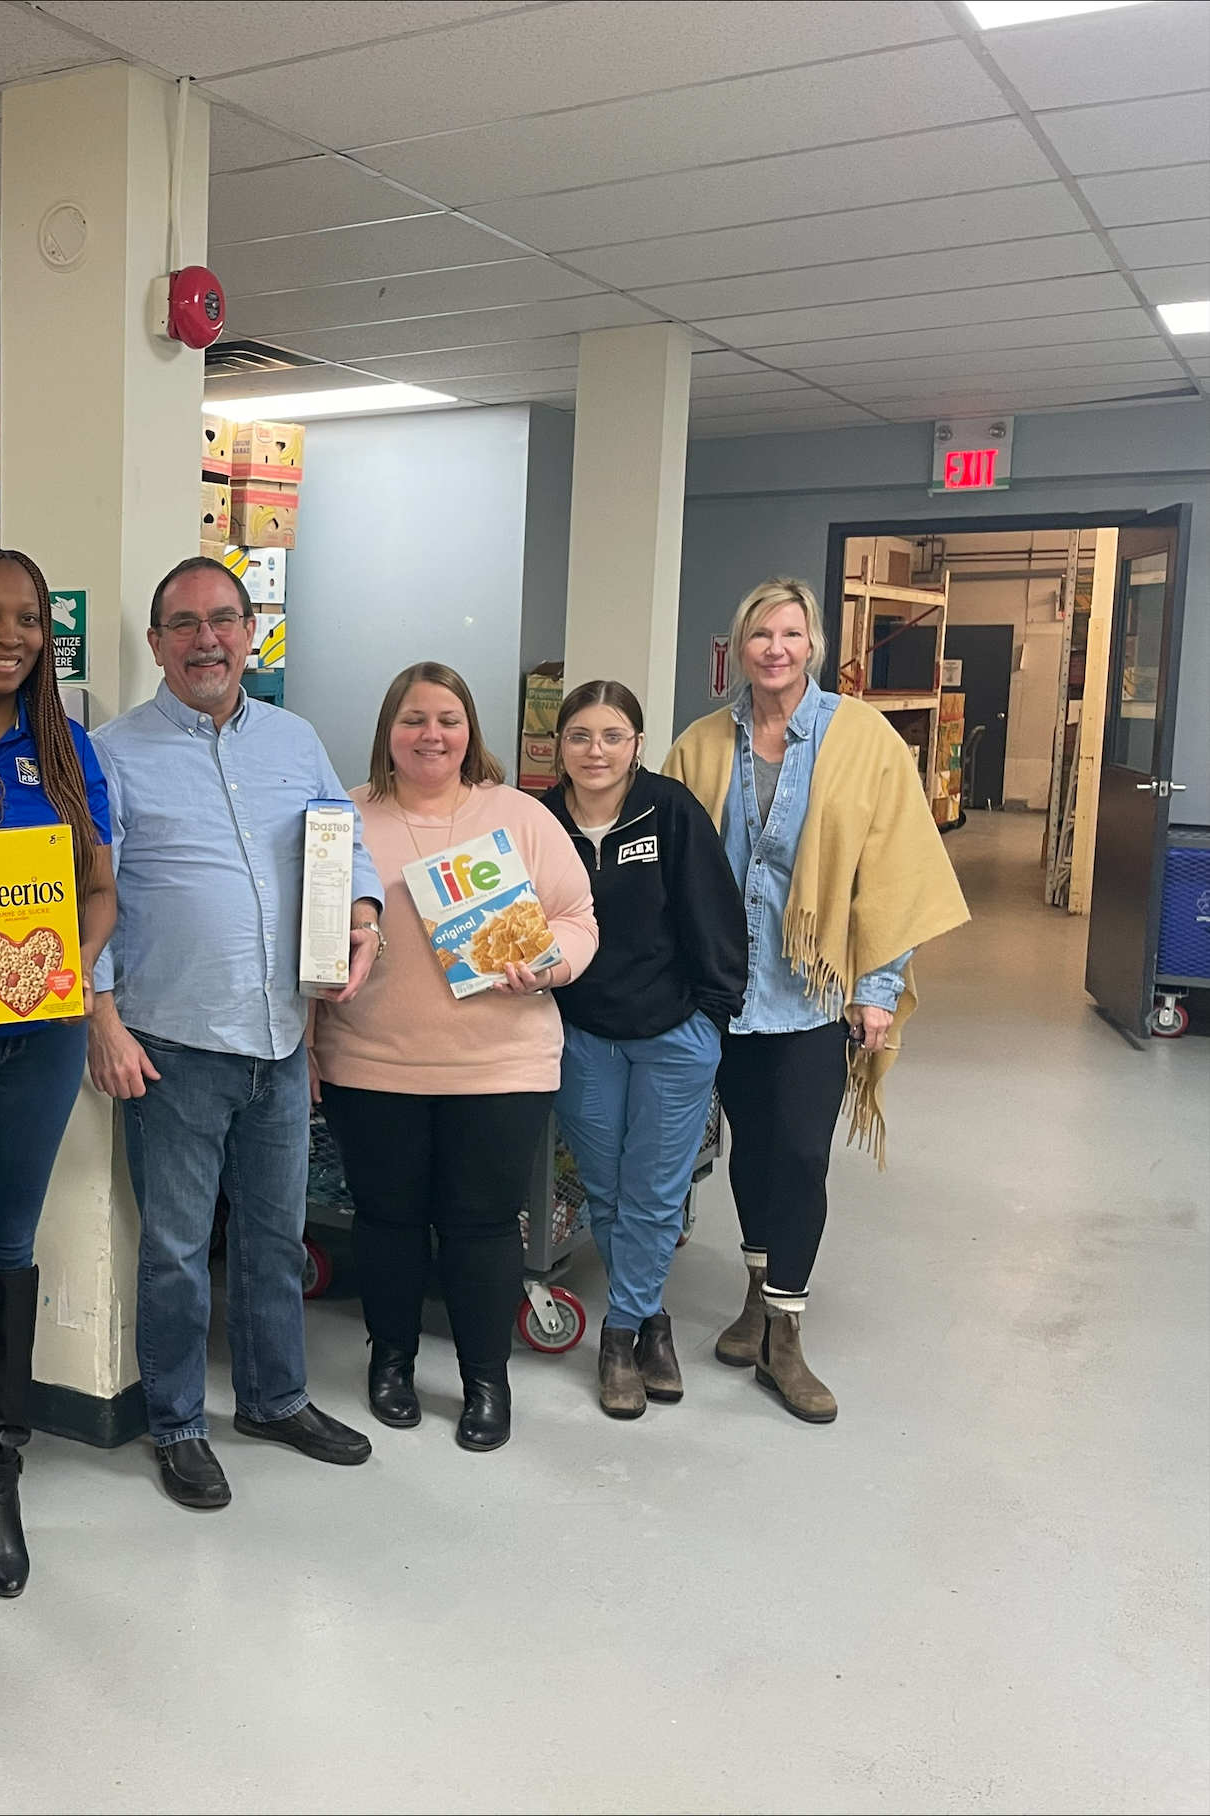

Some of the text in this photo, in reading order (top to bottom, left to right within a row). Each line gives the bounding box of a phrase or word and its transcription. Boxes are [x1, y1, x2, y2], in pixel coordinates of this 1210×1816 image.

[944, 448, 999, 489] EXIT
[53, 637, 81, 646] NITIZE
[56, 657, 72, 666] ERE
[529, 690, 562, 700] Premiu
[531, 745, 552, 755] Dole
[21, 773, 40, 785] RBC
[622, 841, 654, 858] FLEX
[427, 854, 501, 907] life
[29, 907, 50, 915] SUCRE
[435, 916, 477, 945] original
